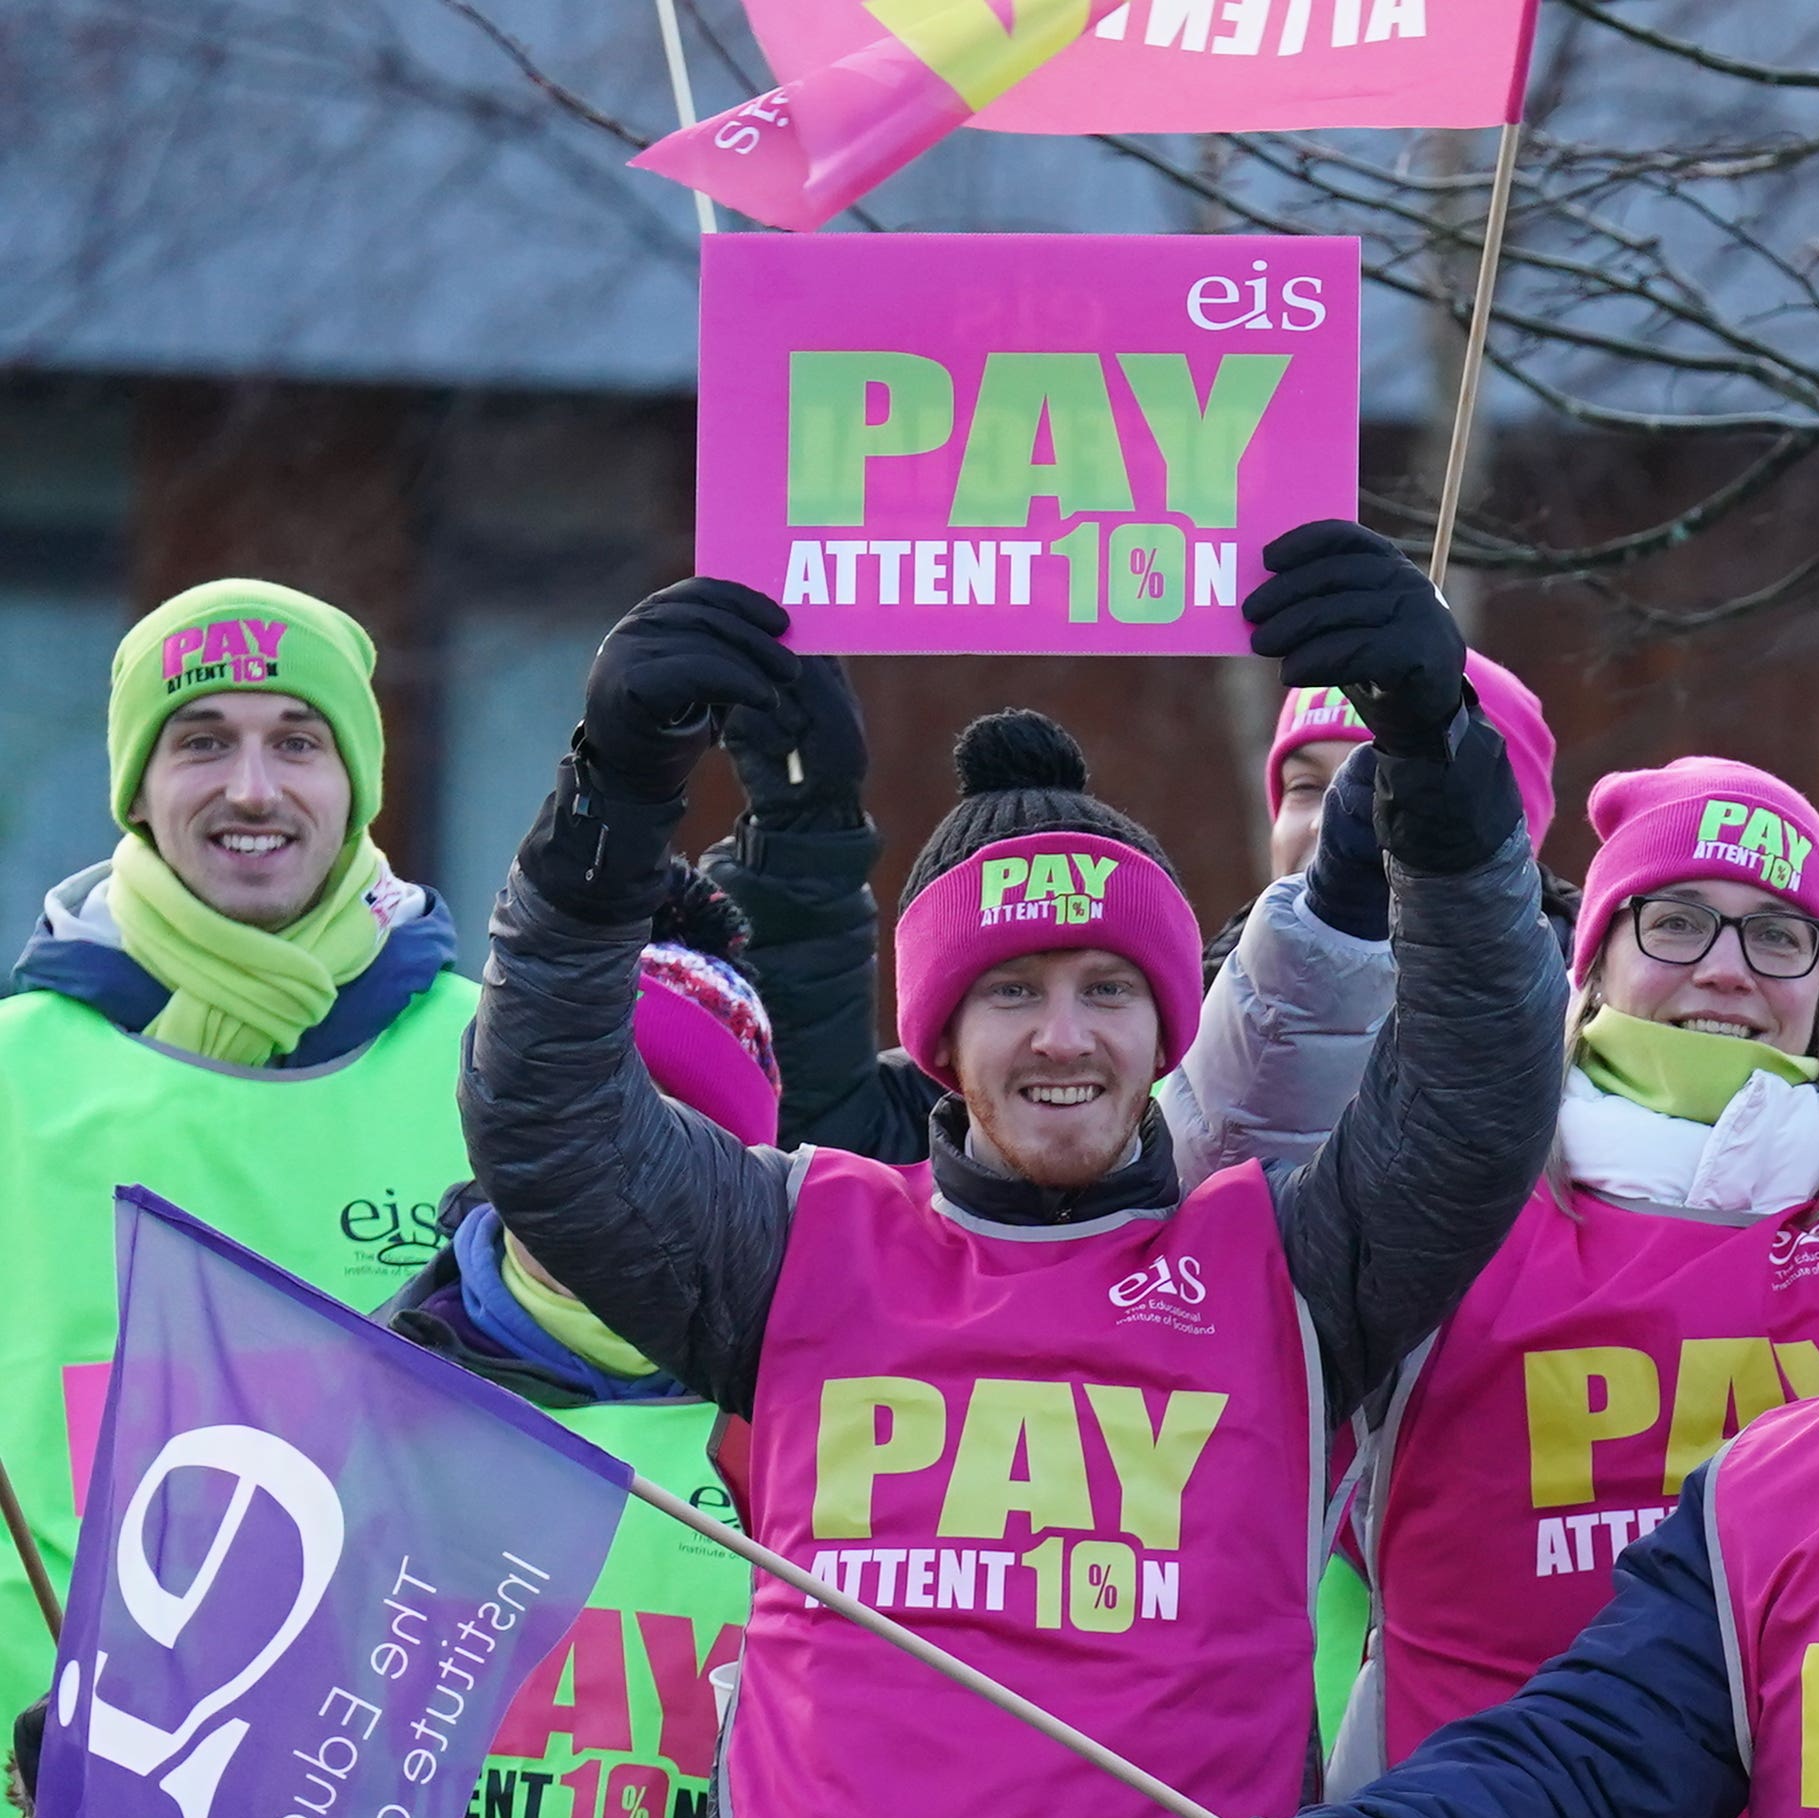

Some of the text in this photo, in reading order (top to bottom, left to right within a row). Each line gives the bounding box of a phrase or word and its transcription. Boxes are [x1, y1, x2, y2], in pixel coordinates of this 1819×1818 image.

[1186, 260, 1328, 332] eis
[787, 351, 1294, 529] PAY
[162, 618, 289, 680] PAY
[1696, 799, 1814, 875] PAY
[980, 853, 1119, 911] PAY
[812, 1375, 1230, 1551] PAY
